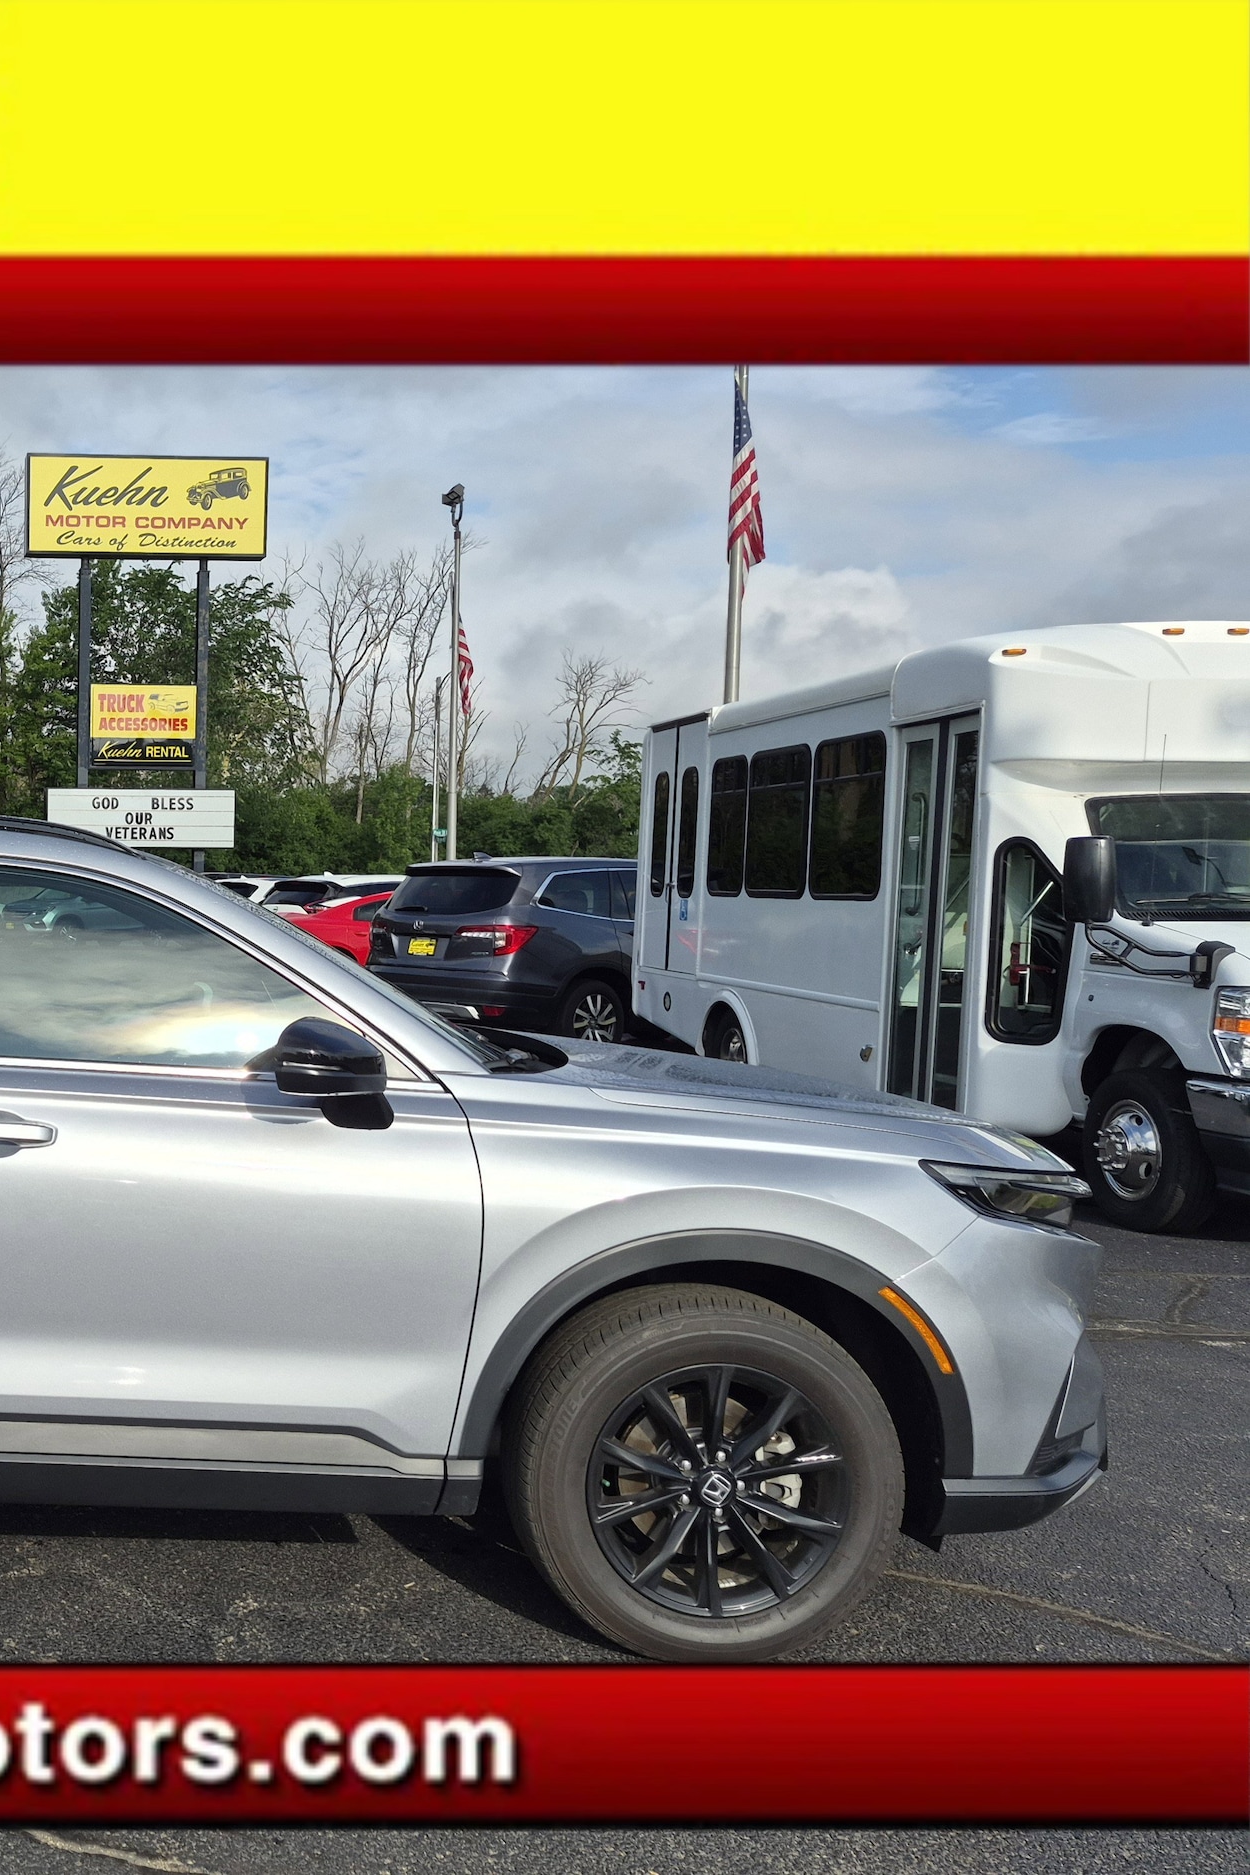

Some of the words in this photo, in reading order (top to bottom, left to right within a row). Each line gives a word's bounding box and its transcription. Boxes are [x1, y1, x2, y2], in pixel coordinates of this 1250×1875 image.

[44, 465, 169, 511] Kuehn
[45, 514, 127, 528] MOTOR
[135, 516, 249, 530] COMPANY
[56, 530, 104, 546] Cars
[109, 534, 130, 551] of
[138, 533, 237, 549] Distinction
[97, 694, 145, 713] TRUCK
[98, 717, 188, 732] ACCESSORIES
[97, 740, 143, 760] Kuehn
[146, 746, 189, 758] RENTAL
[92, 797, 119, 810] GOD
[151, 797, 194, 811] BLESS
[125, 812, 153, 825] OUR
[106, 826, 174, 840] VETERANS
